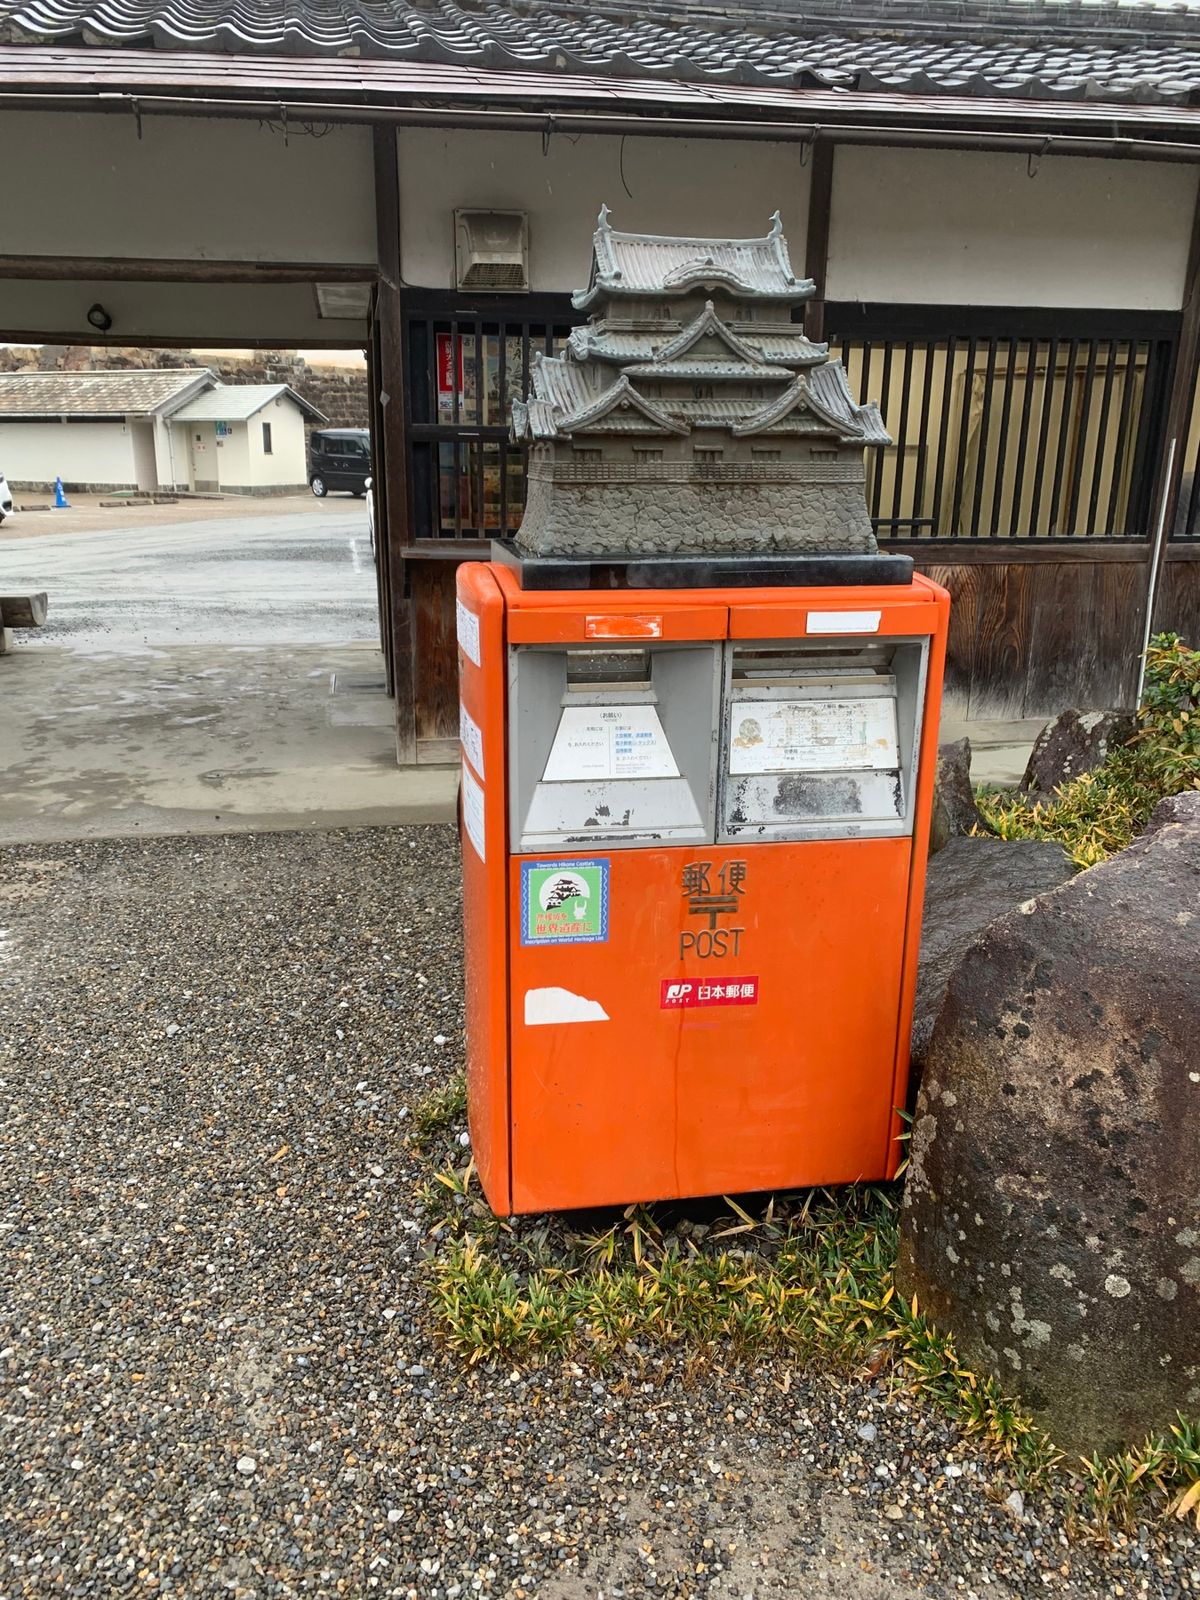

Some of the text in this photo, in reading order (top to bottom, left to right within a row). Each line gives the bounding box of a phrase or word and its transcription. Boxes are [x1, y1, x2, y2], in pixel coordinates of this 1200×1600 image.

[681, 860, 747, 897] 郵便
[536, 922, 592, 935] 世界遺産に
[680, 928, 745, 961] POST
[698, 983, 755, 1001] 日本郵便
